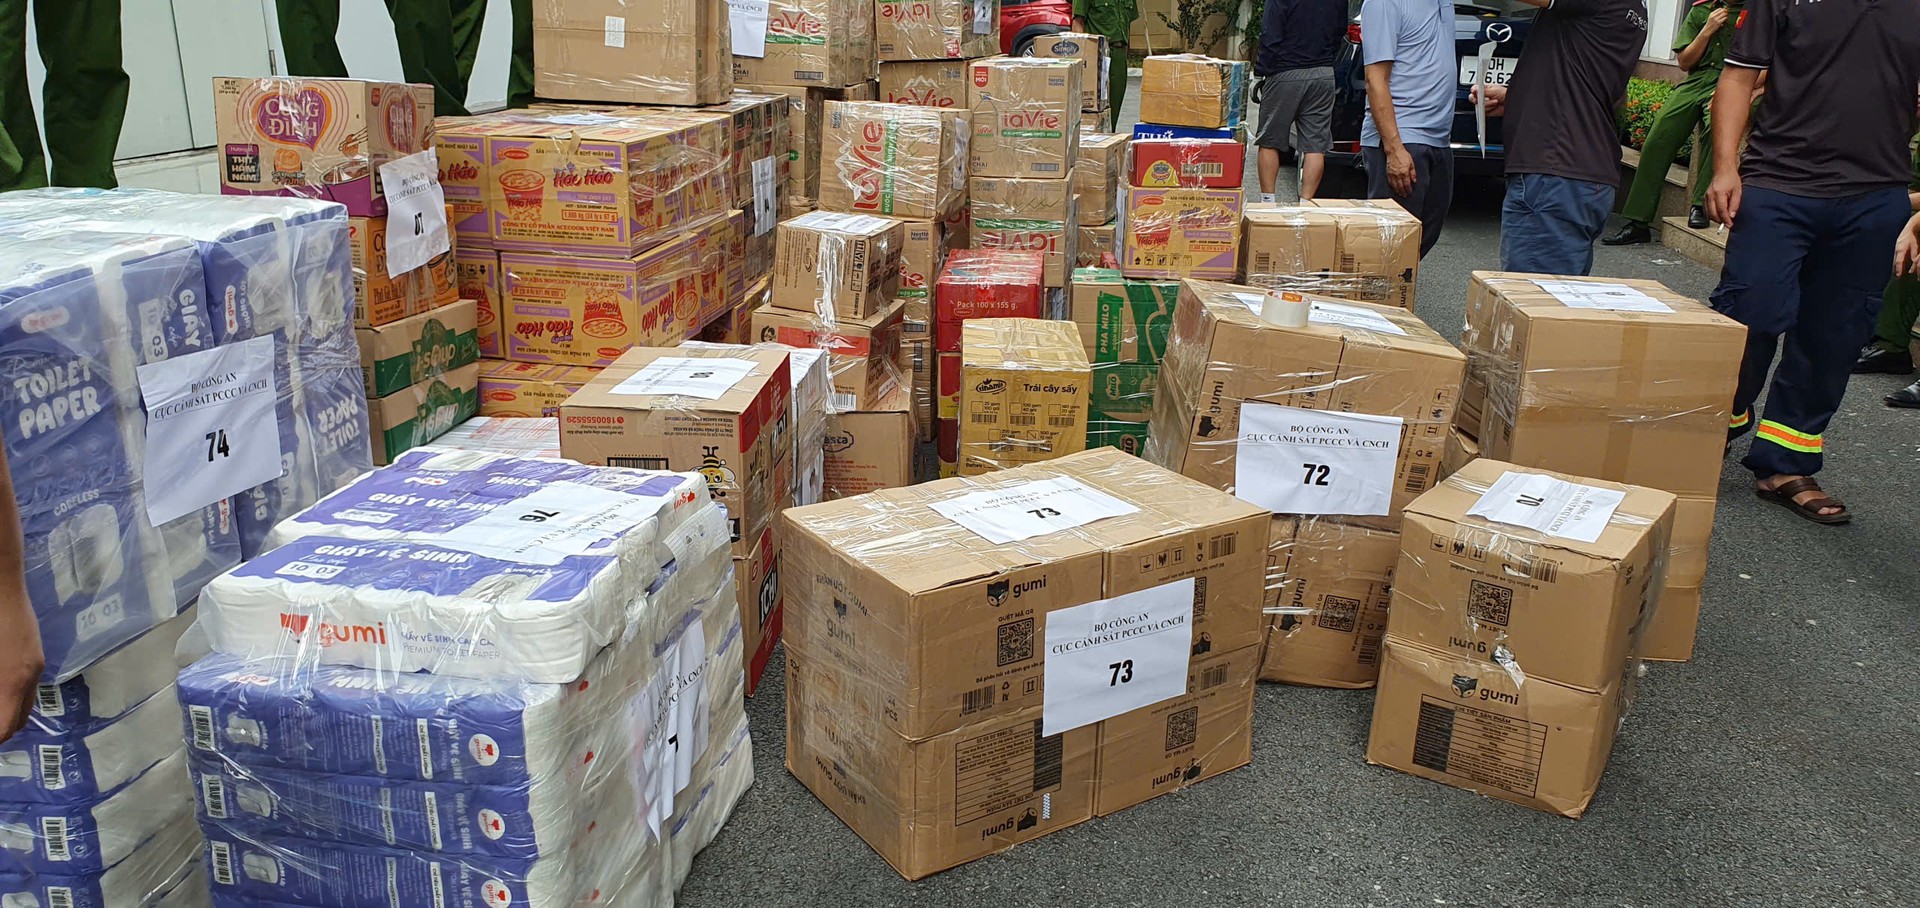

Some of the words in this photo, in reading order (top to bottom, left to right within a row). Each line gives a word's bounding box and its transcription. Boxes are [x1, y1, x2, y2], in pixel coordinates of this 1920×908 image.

[957, 301, 975, 309] Pack
[1101, 303, 1111, 332] MILO
[1100, 333, 1109, 354] PHA
[13, 357, 92, 404] TOILET
[201, 374, 223, 390] CÔNG
[225, 371, 238, 383] AN
[1023, 383, 1041, 393] Trái
[1043, 383, 1060, 394] cây
[1061, 383, 1078, 395] sấy
[1110, 376, 1118, 397] MILO
[154, 405, 174, 420] CỤC
[194, 391, 211, 407] SÁT
[212, 388, 237, 402] PCCC
[1210, 379, 1225, 414] gumi
[18, 386, 101, 439] PAPER
[317, 393, 359, 434] PAPER
[566, 416, 617, 424] 1800555529
[1290, 424, 1304, 435] BỘ
[1306, 423, 1335, 435] CÔNG
[205, 429, 231, 463] 74
[1246, 433, 1268, 444] CỤC
[1268, 433, 1297, 444] CẢNH
[1298, 434, 1318, 445] SÁT
[1319, 438, 1346, 446] PCCC
[1347, 437, 1361, 447] VÀ
[1362, 440, 1390, 449] CNCH
[1302, 463, 1331, 487] 72
[53, 488, 100, 516] CORELESS
[456, 501, 498, 512] SIN
[1515, 494, 1545, 508] 70
[518, 509, 562, 523] 76
[1026, 507, 1062, 519] 73
[408, 549, 472, 564] SINH
[1013, 574, 1047, 598] gumi
[826, 617, 856, 647] gumi
[1094, 620, 1108, 633] BỘ
[1109, 614, 1136, 630] CÔNG
[1136, 611, 1150, 623] AN
[1052, 643, 1073, 655] CỤC
[1074, 634, 1101, 650] CẢNH
[1102, 630, 1120, 644] SÁT
[1121, 627, 1146, 641] PCCC
[1147, 621, 1160, 633] VÀ
[1160, 615, 1185, 630] CNCH
[1448, 636, 1488, 653] gumi
[1108, 658, 1134, 687] 73
[1479, 687, 1520, 706] gumi
[884, 707, 899, 722] PCS
[1152, 766, 1181, 790] gumi
[982, 817, 1015, 841] gumi
